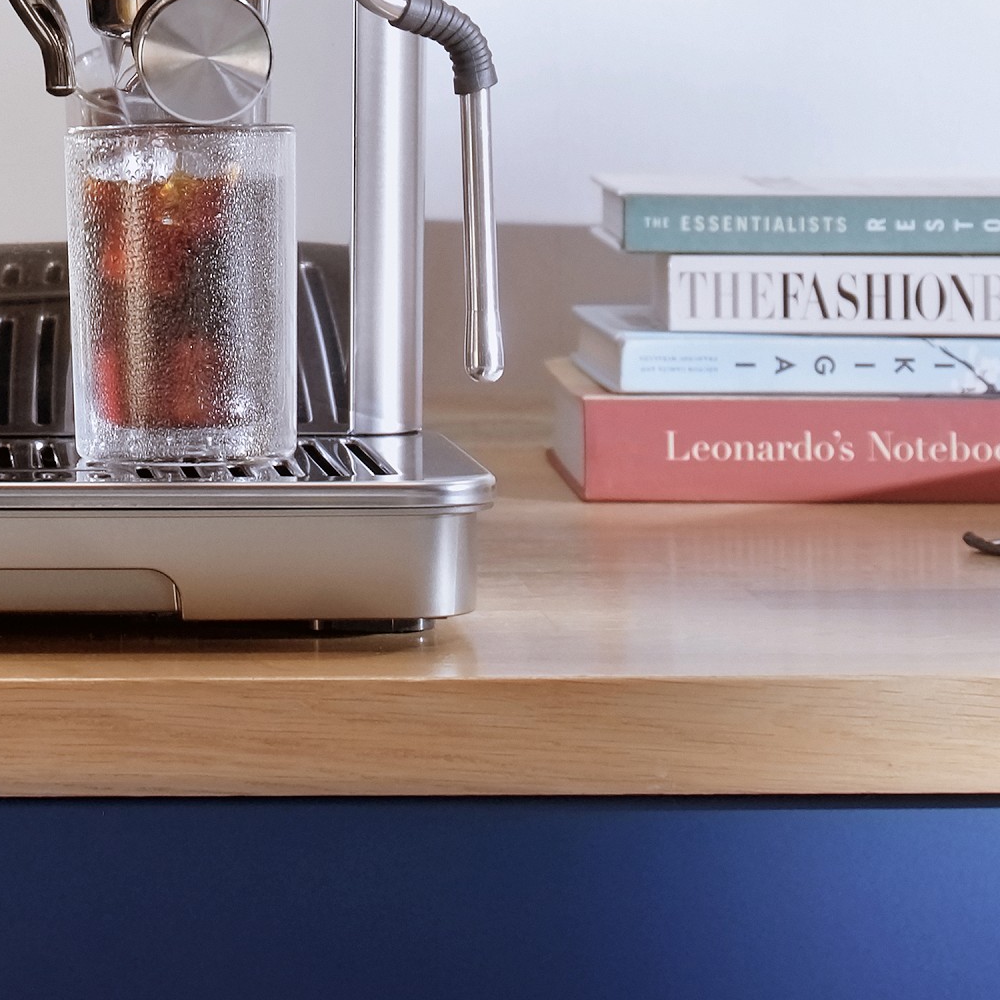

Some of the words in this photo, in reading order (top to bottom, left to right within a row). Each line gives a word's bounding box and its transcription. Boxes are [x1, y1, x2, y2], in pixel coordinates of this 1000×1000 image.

[643, 216, 670, 229] THE
[680, 215, 848, 233] ESSENTIALISTS
[665, 429, 855, 462] Leonardo's
